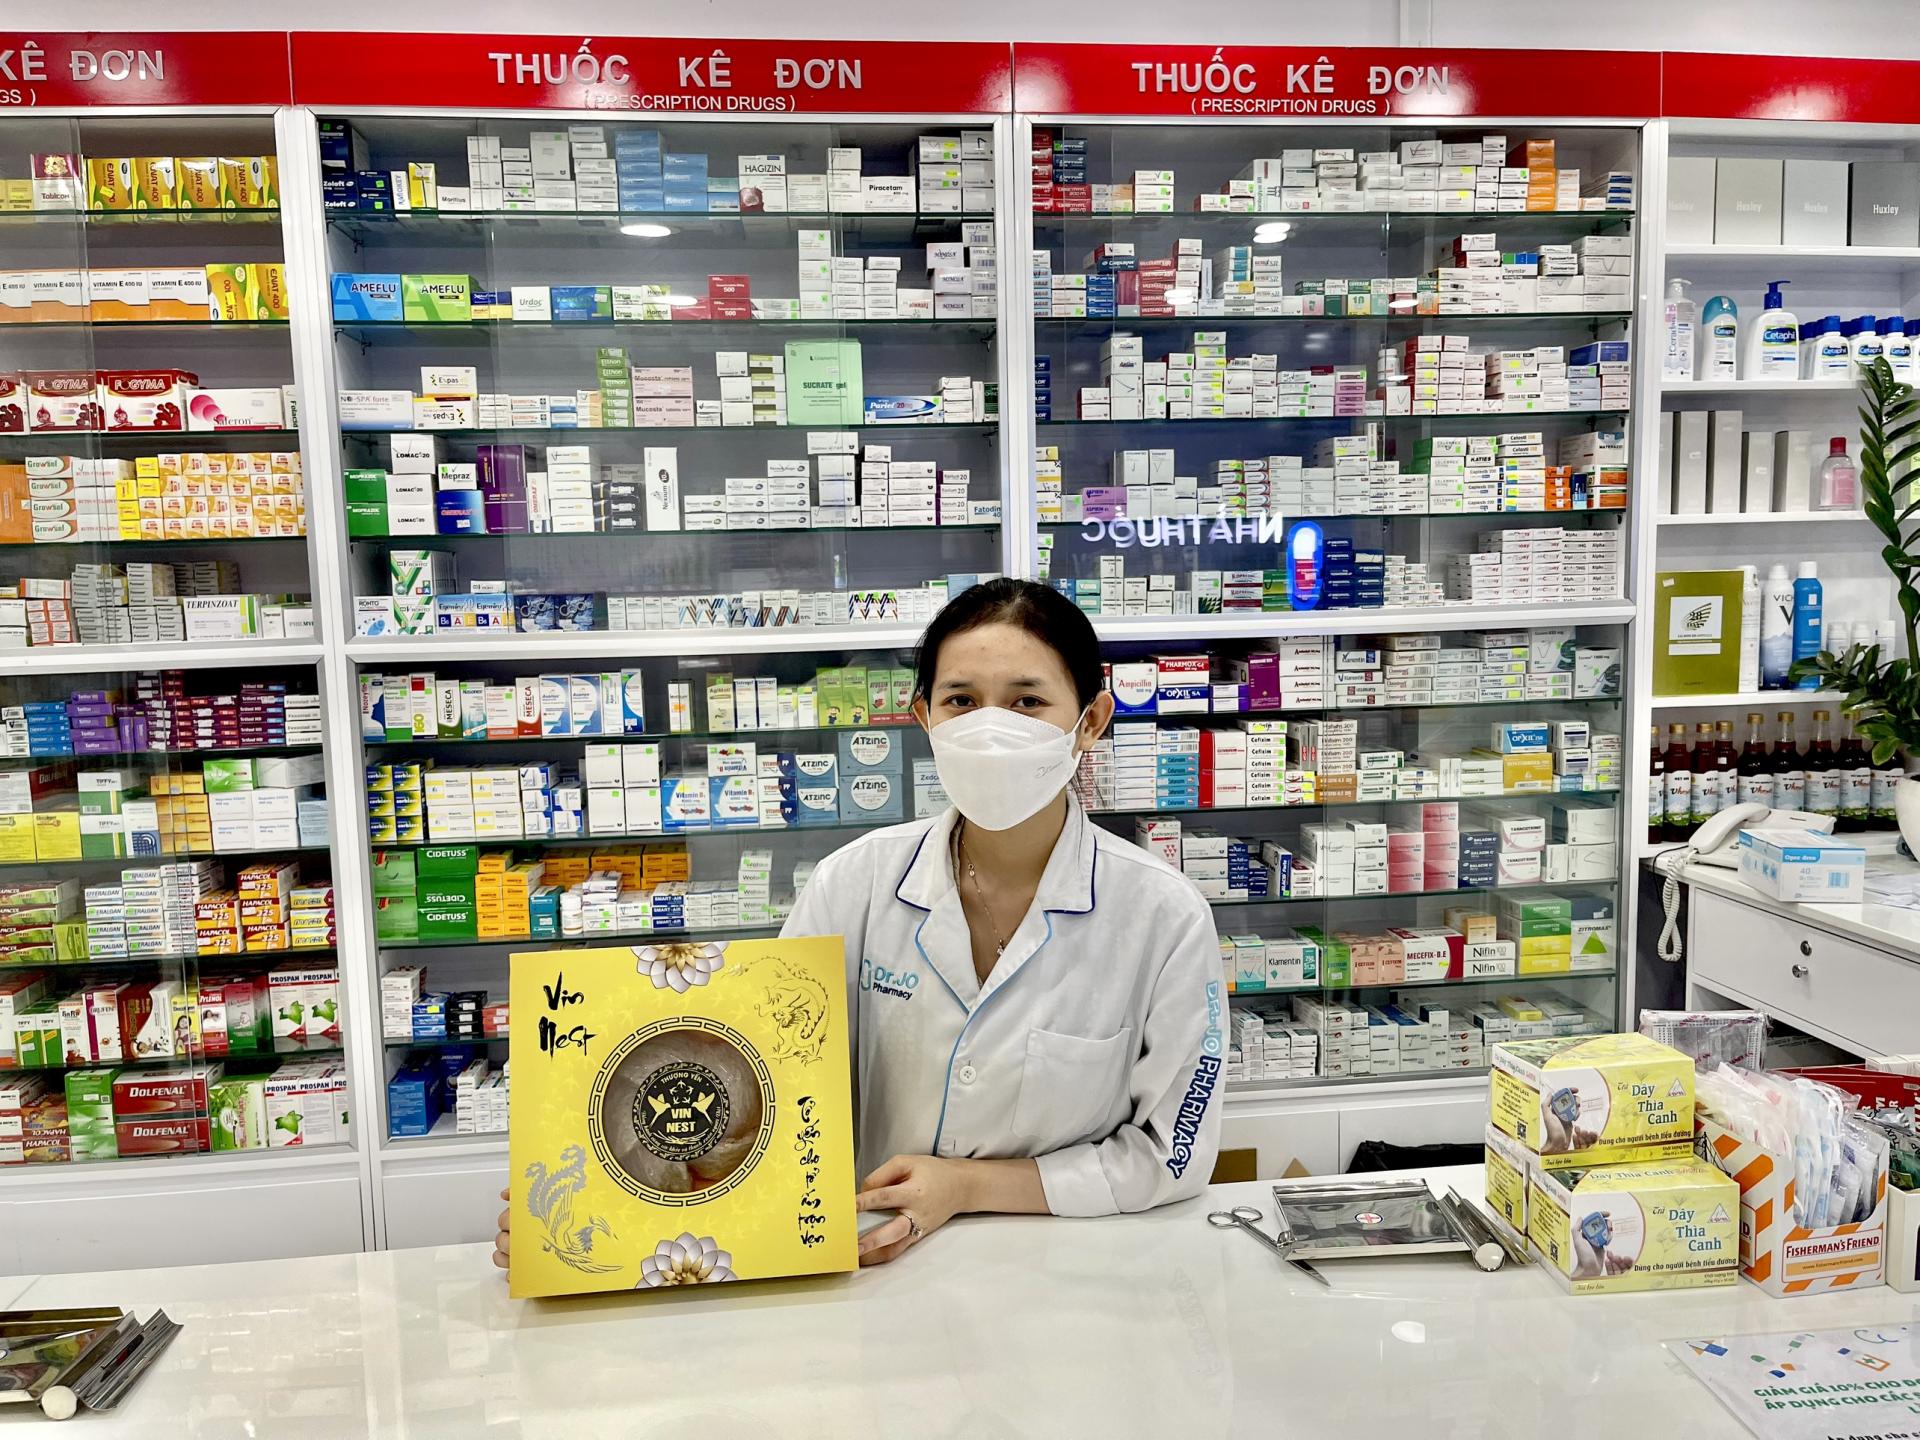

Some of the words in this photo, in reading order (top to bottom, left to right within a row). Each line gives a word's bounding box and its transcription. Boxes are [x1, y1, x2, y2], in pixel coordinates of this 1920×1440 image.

[69, 50, 164, 81] ĐƠN
[488, 38, 630, 86] THUỐC
[678, 49, 732, 88] KÊ
[774, 58, 862, 90] ĐƠN
[1131, 47, 1256, 95] THUỐC
[1286, 56, 1335, 95] KÊ
[1367, 66, 1449, 96] ĐƠN
[595, 95, 721, 111] PRESCRIPTION
[726, 96, 787, 111] DRUGS
[1200, 99, 1318, 114] PRESCRIPTION
[1321, 100, 1377, 115] DRUGS
[744, 164, 782, 174] HAGIZIN
[869, 184, 903, 193] Piracetam
[1736, 201, 1762, 213] Huxley
[1803, 202, 1829, 214] Huxley
[1873, 204, 1899, 215] Huxley
[59, 280, 65, 288] E
[93, 280, 119, 288] VITAMIN
[118, 280, 125, 288] E
[178, 279, 184, 287] E
[351, 282, 397, 294] AMEFLU
[421, 284, 465, 295] AMEFLU
[803, 381, 833, 391] SUCRATE
[441, 471, 471, 481] Mepraz
[186, 598, 238, 609] TERPINZOAT
[1165, 661, 1196, 669] PHARMOX
[525, 685, 533, 717] MESECA
[426, 849, 467, 858] CIDETUSS
[255, 883, 273, 891] 325
[86, 890, 120, 898] EFFERALGAN
[197, 903, 229, 911] HAPACOL
[242, 899, 272, 907] HAPACOL
[257, 909, 274, 917] 325
[426, 912, 467, 921] CIDETUSS
[200, 928, 230, 936] HAPACOL
[248, 924, 278, 932] HAPACOL
[214, 938, 231, 947] 325
[262, 933, 280, 942] 325
[1473, 946, 1496, 957] Nifin
[1268, 957, 1301, 966] Klamentin
[1473, 963, 1496, 974] Nifin
[270, 975, 300, 983] PROSPAN
[303, 974, 333, 982] PROSPAN
[874, 966, 919, 989] Dr.JO
[872, 982, 913, 1001] Pharmacy
[267, 1084, 297, 1092] PROSPAN
[300, 1082, 330, 1090] PROSPAN
[1632, 1083, 1655, 1098] Dây
[129, 1086, 185, 1098] DOLFENAL
[671, 1107, 692, 1119] VIN
[1167, 1055, 1222, 1180] PHARMACY
[1648, 1110, 1677, 1125] Canh
[133, 1126, 189, 1137] DOLFENAL
[666, 1121, 696, 1133] NEST
[25, 1139, 62, 1148] HAPACOL
[800, 1148, 820, 1166] cho
[1668, 1208, 1695, 1223] Dây
[1675, 1225, 1706, 1238] Thìa
[1688, 1237, 1722, 1252] Canh
[1786, 1239, 1846, 1259] FISHERMAN'S
[1846, 1236, 1880, 1251] FRIEND
[1652, 1262, 1664, 1271] cho
[1753, 1384, 1798, 1397] GIẢM
[1799, 1383, 1830, 1395] GIÁ
[1829, 1382, 1865, 1393] 10%
[1864, 1380, 1901, 1390] CHO
[1764, 1398, 1787, 1411] ÁP
[1788, 1398, 1841, 1411] DỤNG
[1841, 1395, 1879, 1406] CHO
[1878, 1390, 1913, 1402] CÁC
